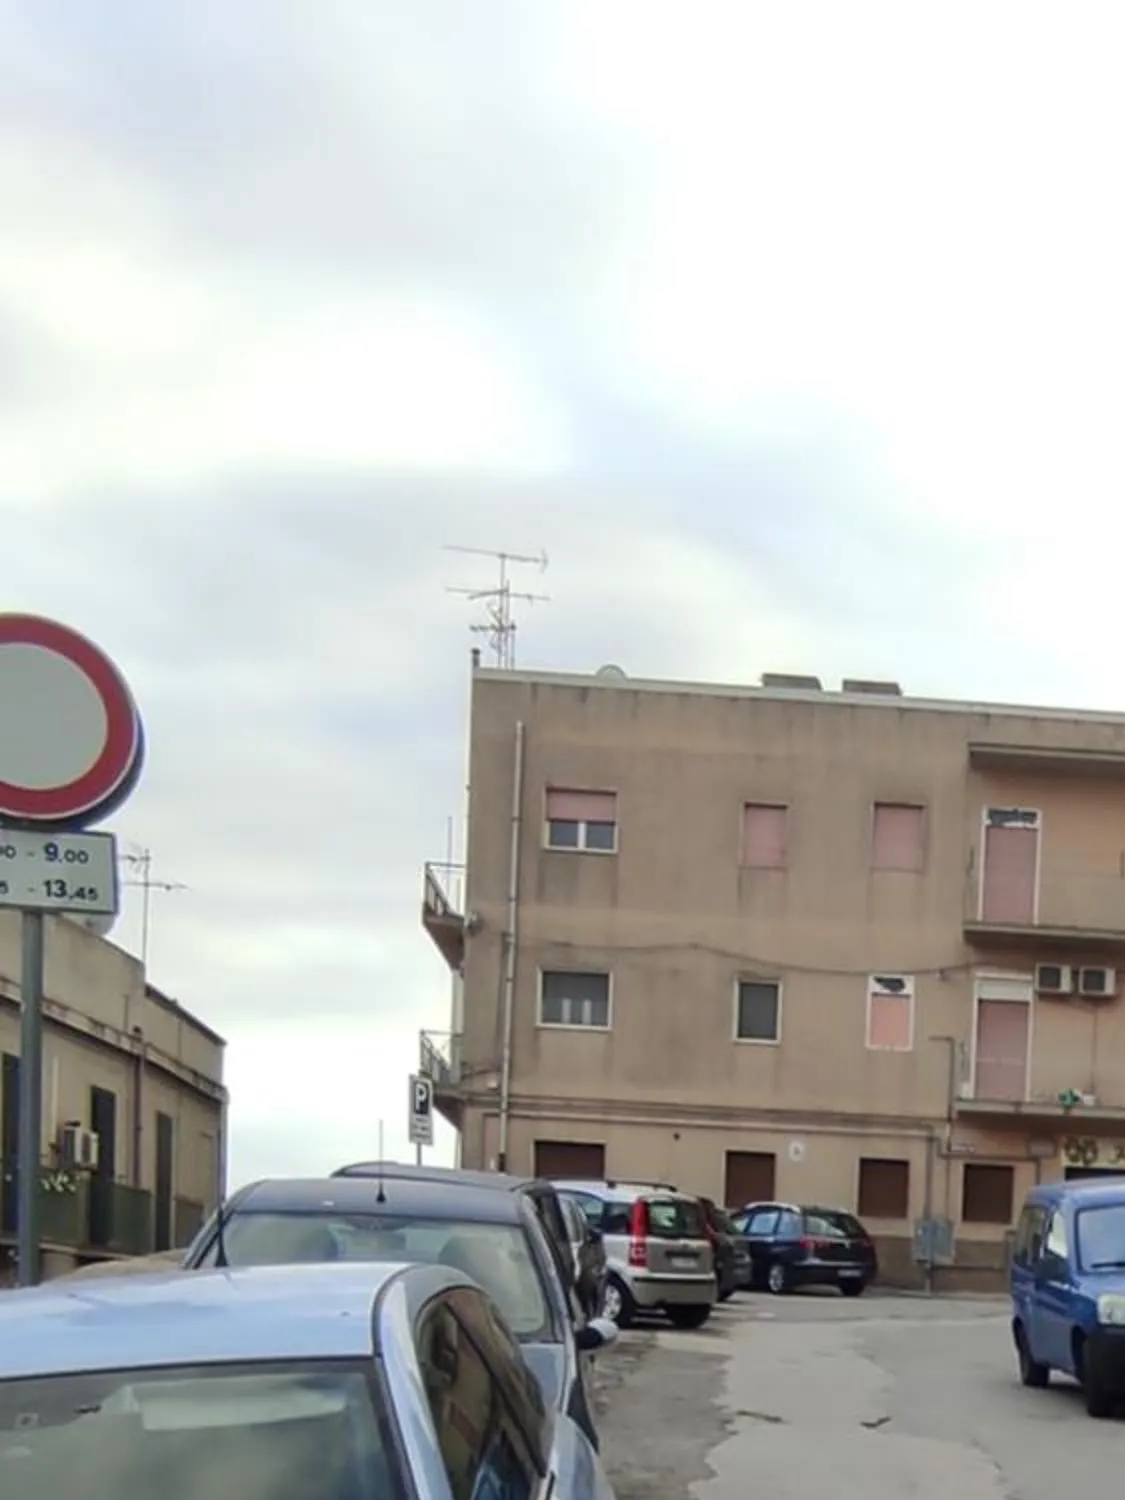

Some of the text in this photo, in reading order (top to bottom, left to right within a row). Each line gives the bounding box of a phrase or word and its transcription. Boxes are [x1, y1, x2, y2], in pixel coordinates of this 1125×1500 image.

[0, 844, 17, 860] 0
[44, 842, 89, 864] 9.00
[415, 1083, 427, 1110] P
